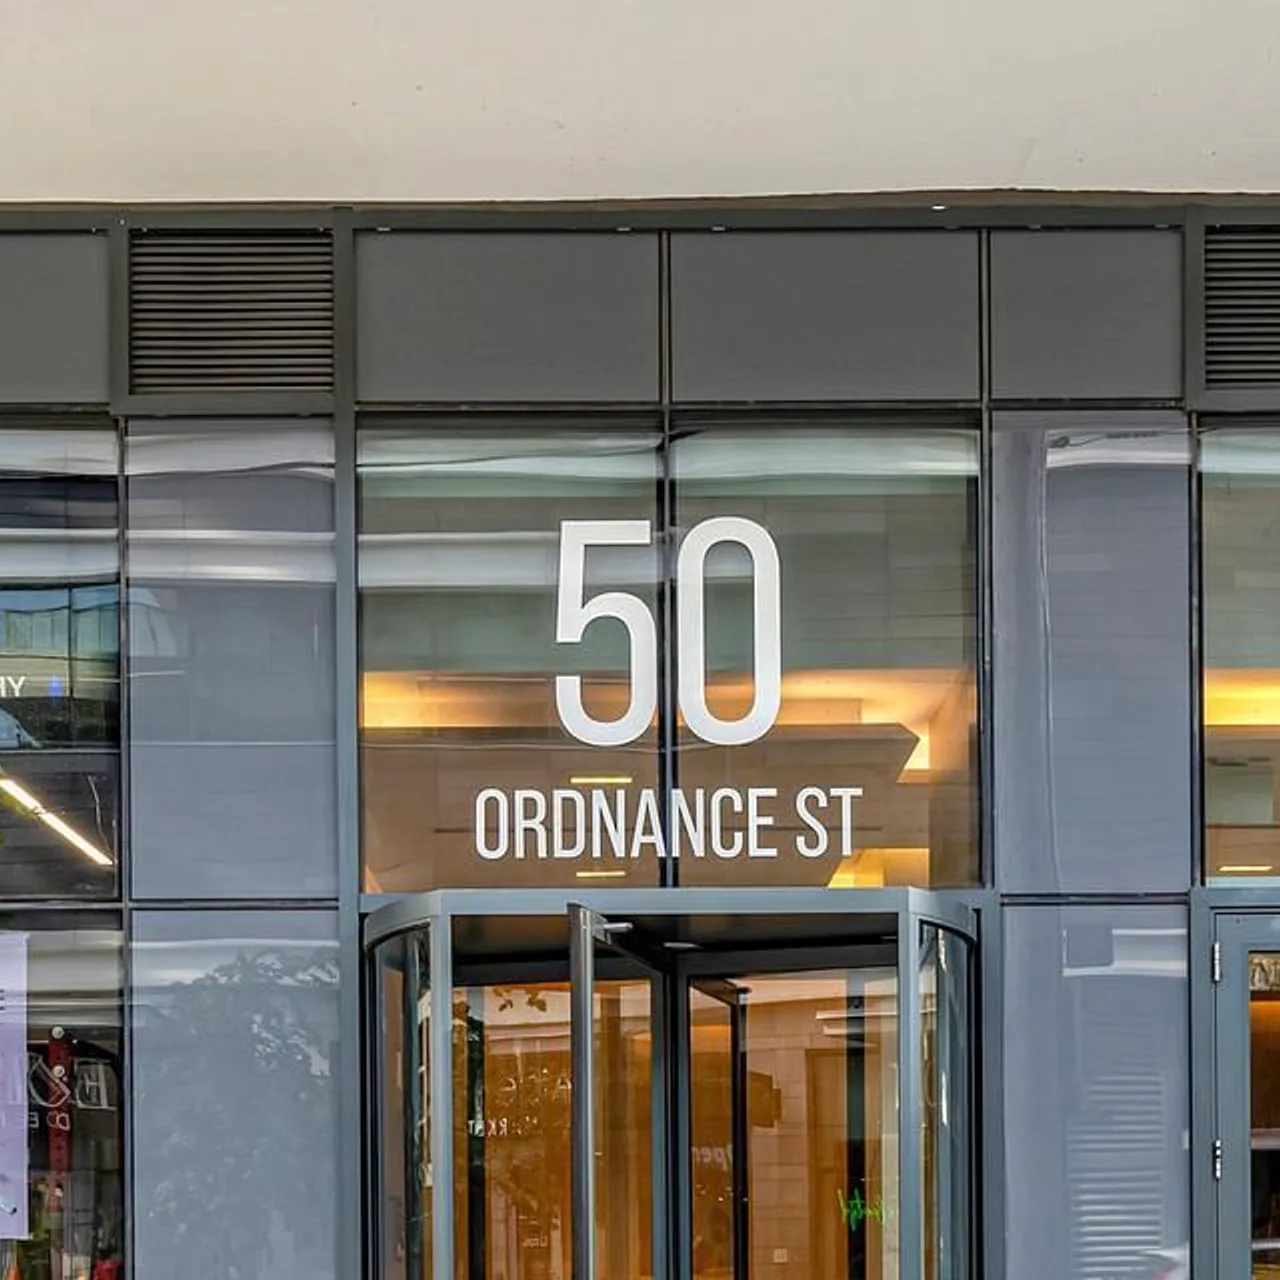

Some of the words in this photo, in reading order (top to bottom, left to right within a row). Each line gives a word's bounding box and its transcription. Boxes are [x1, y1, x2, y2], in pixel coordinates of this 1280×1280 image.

[555, 515, 781, 747] 50
[474, 787, 778, 859] ORDNANCE
[795, 787, 863, 858] ST
